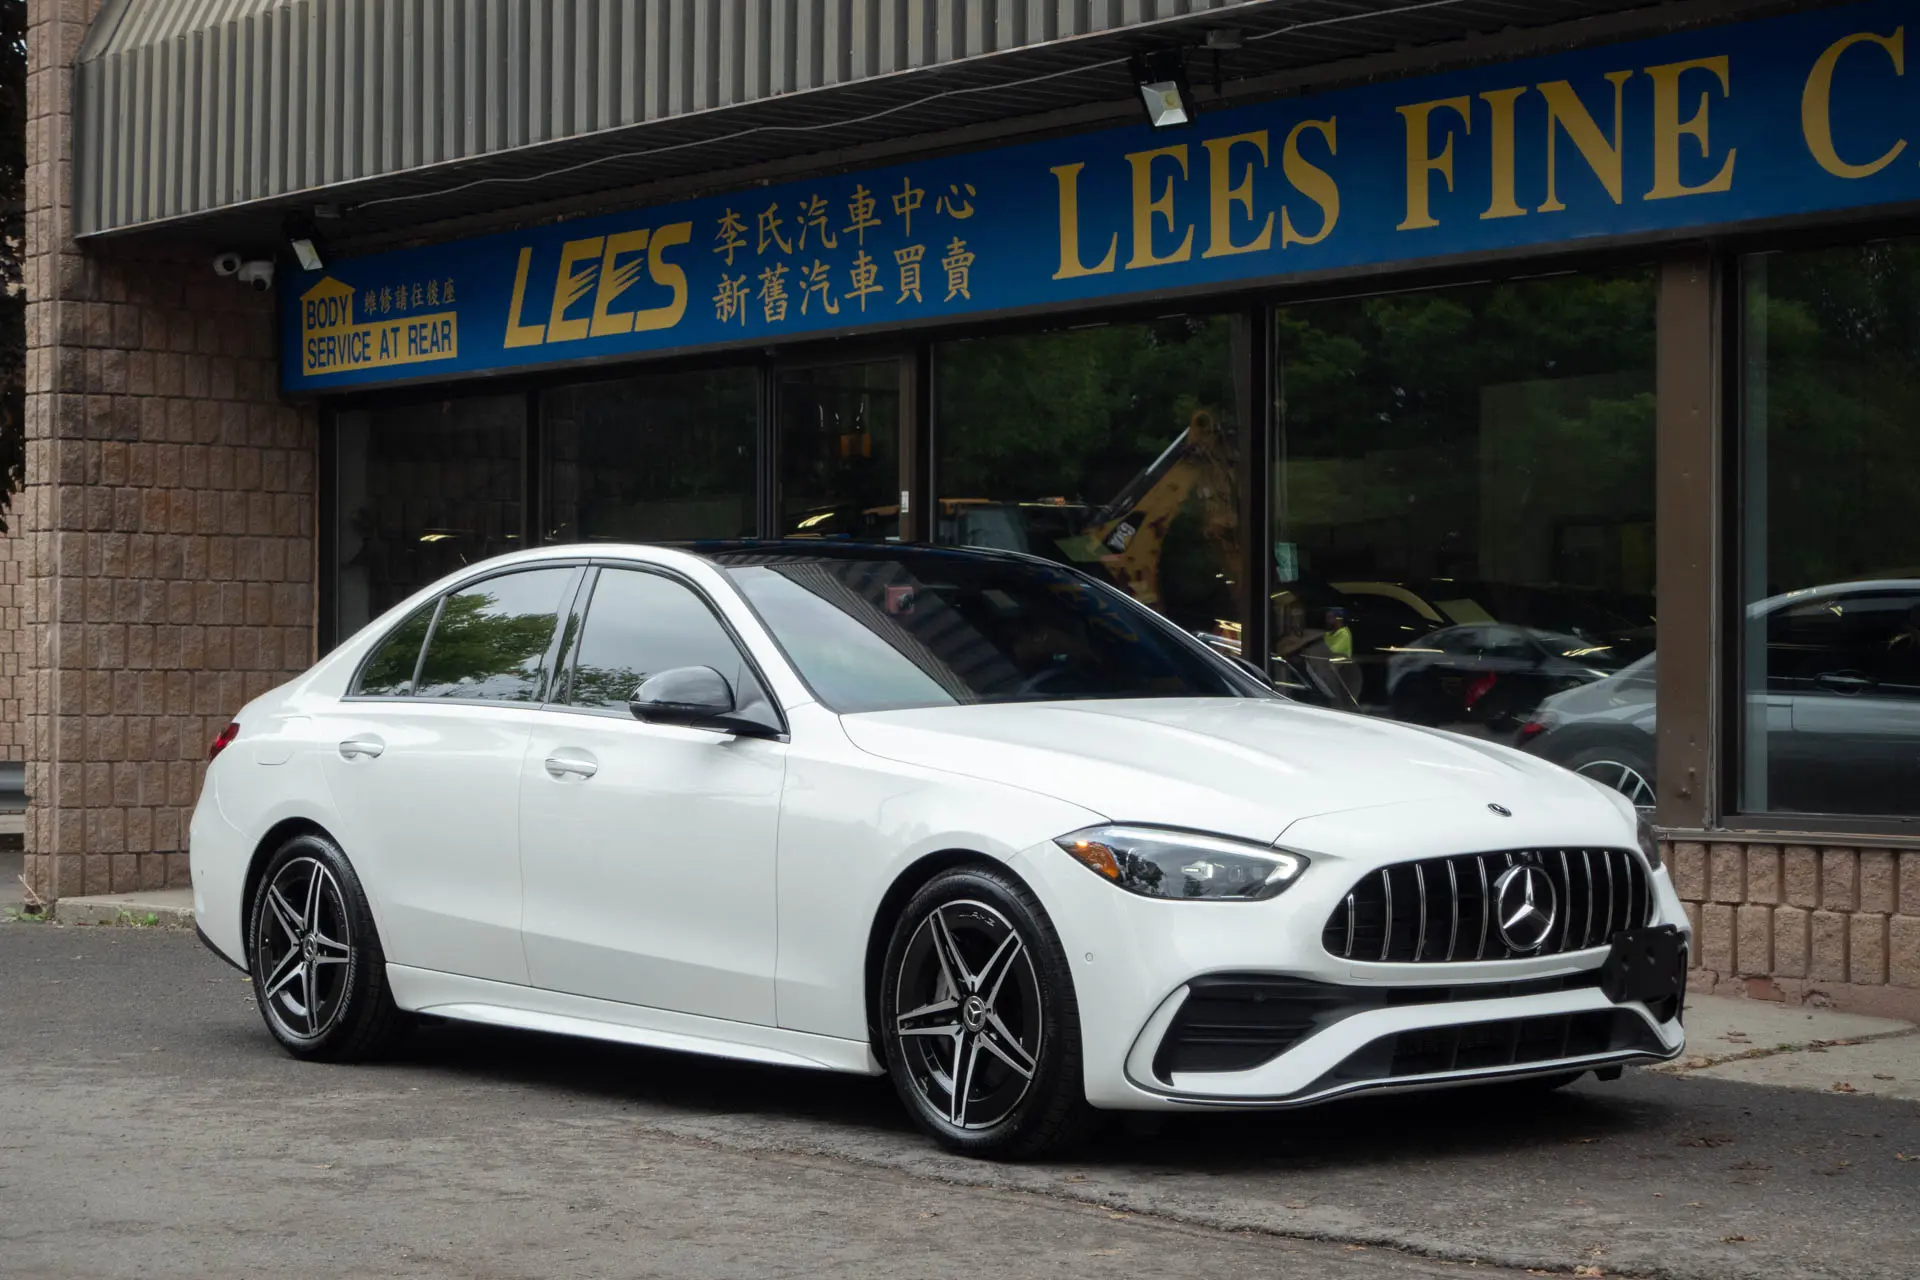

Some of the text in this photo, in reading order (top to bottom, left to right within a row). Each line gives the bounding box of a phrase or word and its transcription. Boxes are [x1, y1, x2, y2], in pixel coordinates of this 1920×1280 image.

[1049, 115, 1340, 280] LEES
[1395, 55, 1737, 231] FINE
[712, 177, 977, 267] 李氏汽車中心
[306, 294, 349, 330] BODY
[503, 221, 693, 349] LEES
[712, 236, 976, 327] 新舊汽車買賣
[307, 320, 452, 369] SERVICE AT REAR
